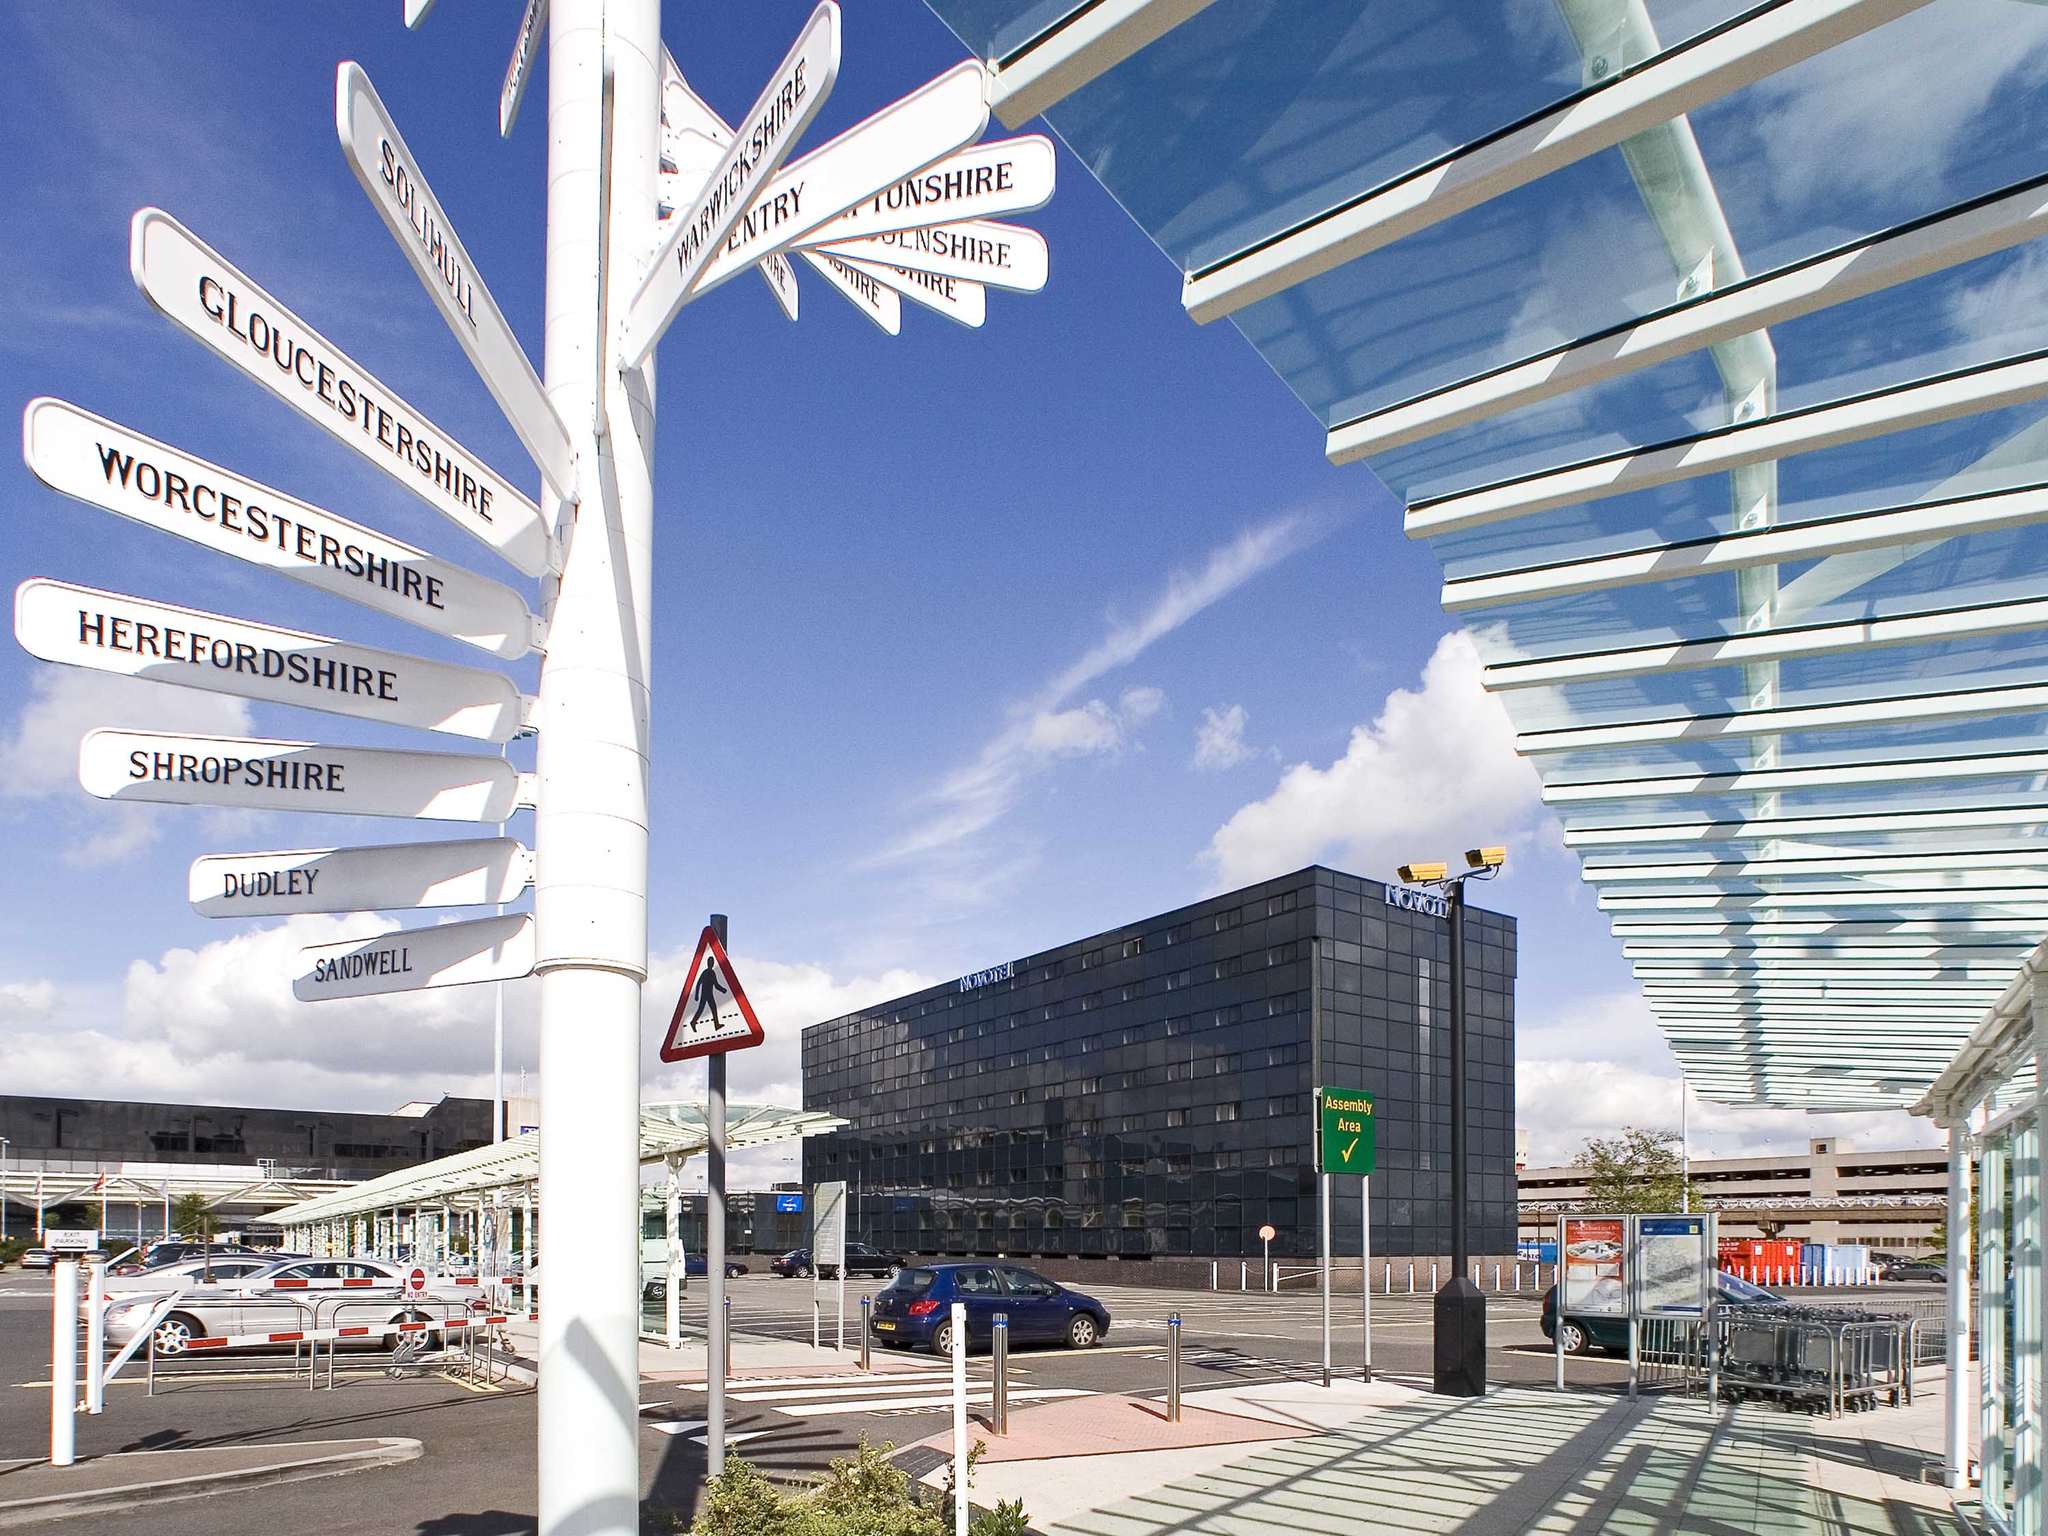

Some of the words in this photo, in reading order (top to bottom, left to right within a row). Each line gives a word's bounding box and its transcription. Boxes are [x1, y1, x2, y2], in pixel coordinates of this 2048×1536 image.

[677, 57, 807, 276] WARWICKSHIRE
[842, 161, 1014, 219] TONSHIRE
[378, 137, 479, 329] SOLIHULL
[715, 181, 805, 259] ENTRY
[198, 274, 495, 523] GLOUCESTERSHIRE
[95, 442, 446, 610] WORCESTERSHIRE
[78, 610, 400, 702] HEREFORDSHIRE
[128, 750, 346, 793] SHROPSHIRE
[223, 868, 320, 899] DUDLEY
[314, 947, 413, 983] SANDWELL
[1325, 1095, 1373, 1116] Assembly
[1337, 1117, 1362, 1133] Area
